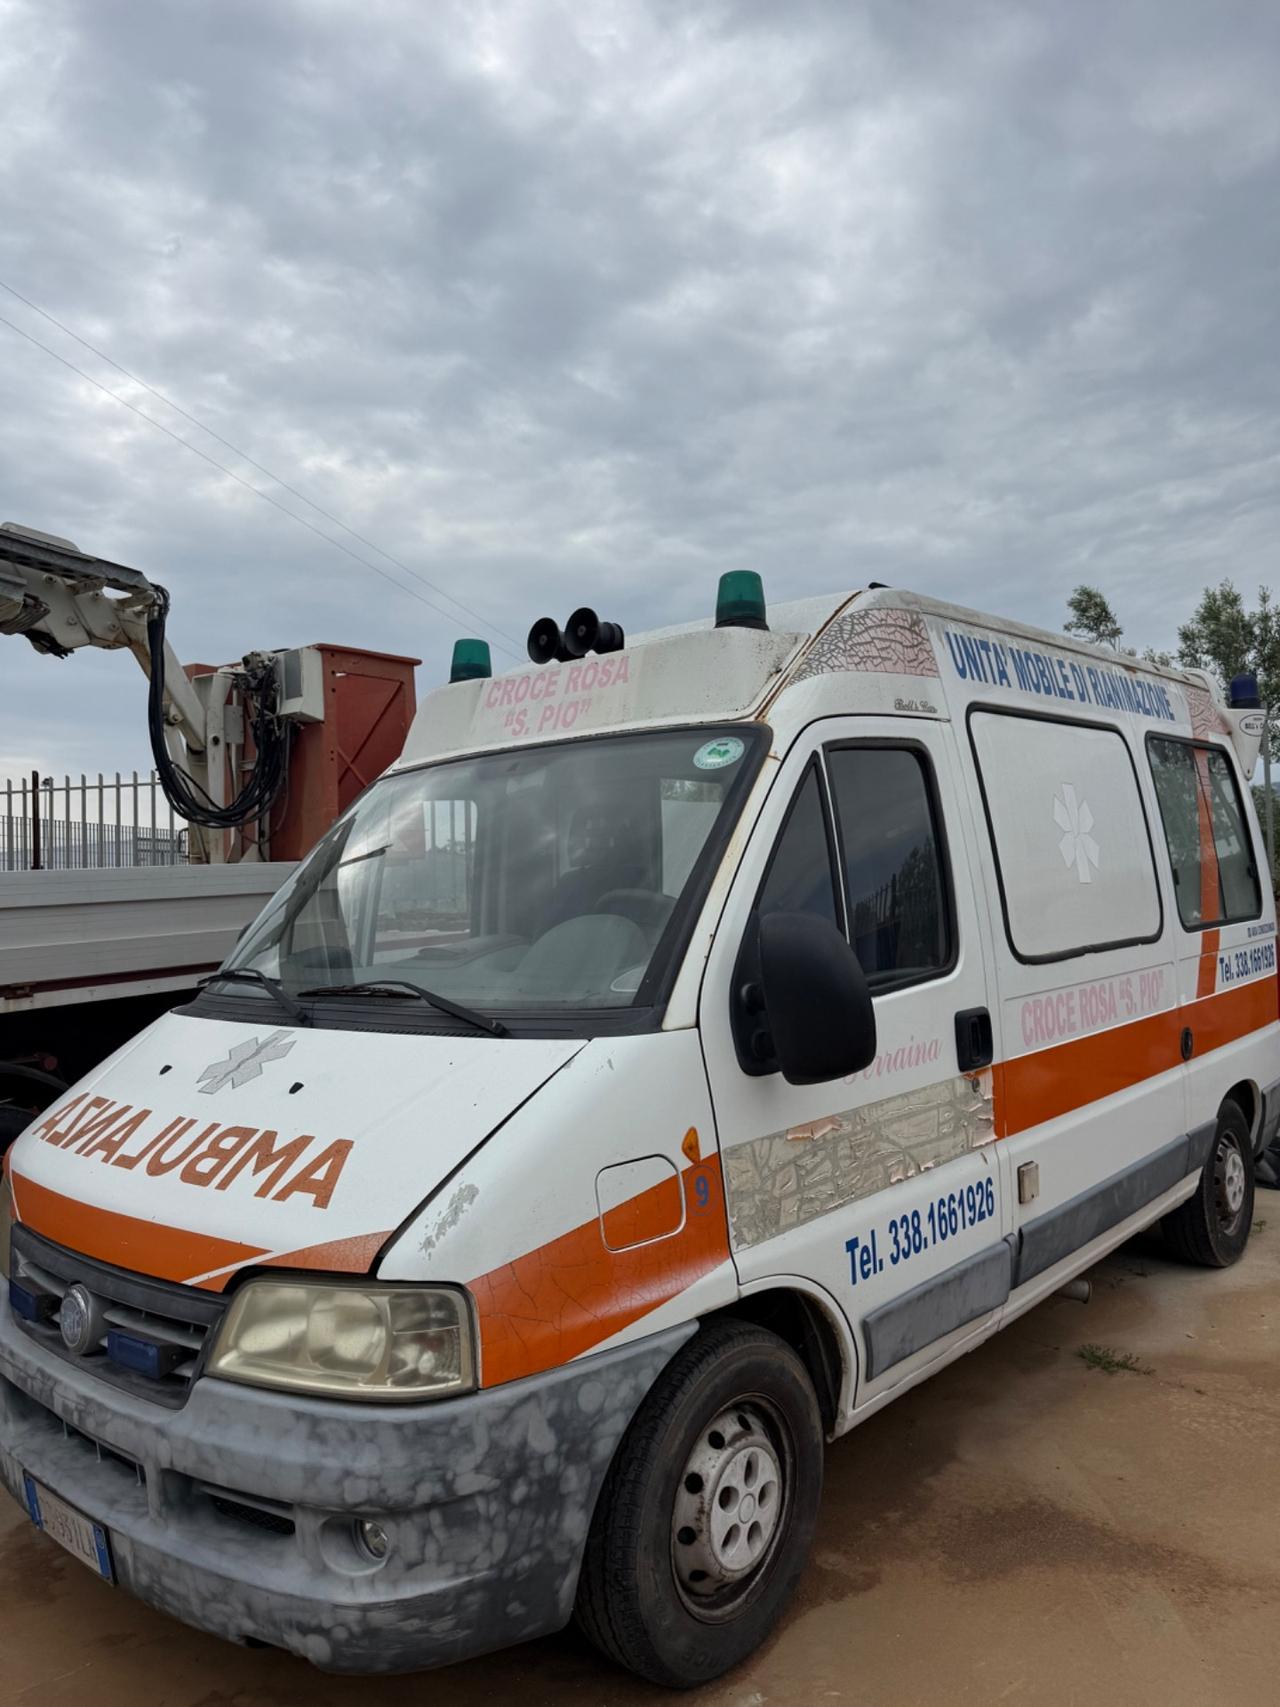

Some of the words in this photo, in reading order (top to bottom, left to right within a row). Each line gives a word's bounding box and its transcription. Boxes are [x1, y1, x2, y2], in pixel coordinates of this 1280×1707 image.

[484, 670, 560, 708] CROCE
[565, 656, 629, 694] ROSA
[1008, 647, 1075, 700] MOBILE
[1070, 662, 1093, 704] DI
[1087, 666, 1176, 721] RIANIMAZIONE
[1219, 955, 1235, 983] Tel.
[1021, 990, 1077, 1046] CROCE
[1079, 983, 1117, 1027] ROSA
[695, 1175, 709, 1207] 9
[845, 1229, 883, 1286] Tel.
[888, 1176, 995, 1265] 338.1661926
